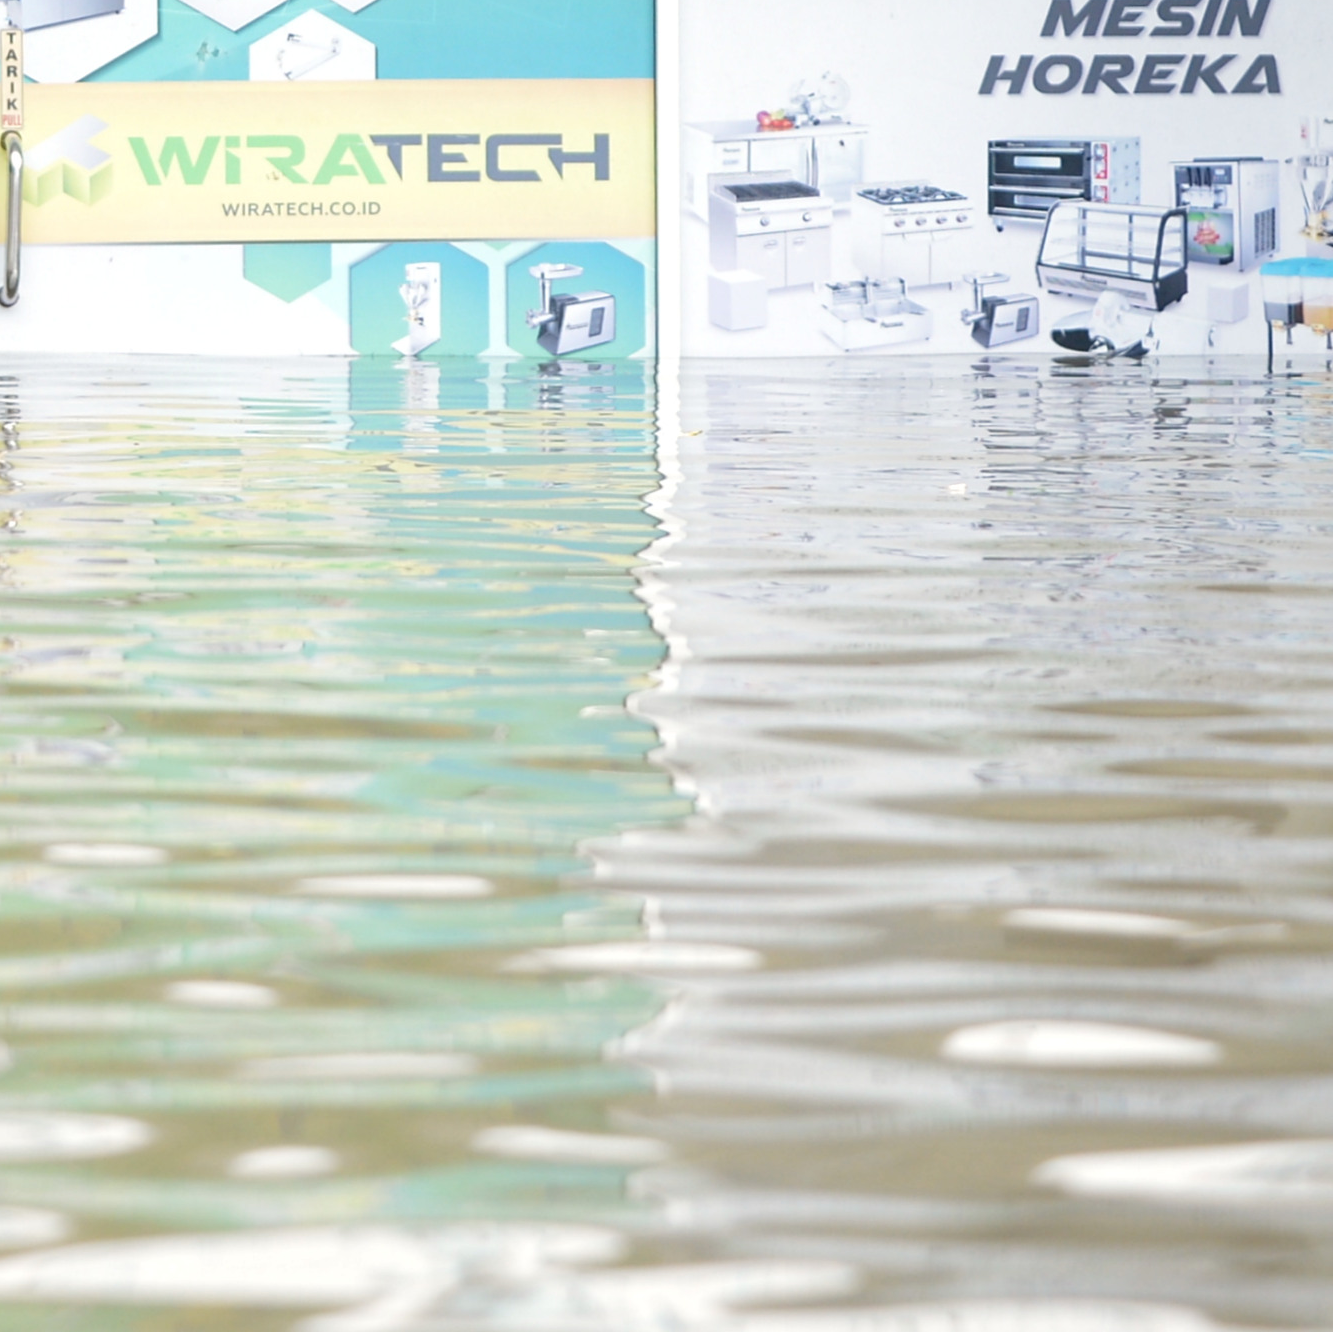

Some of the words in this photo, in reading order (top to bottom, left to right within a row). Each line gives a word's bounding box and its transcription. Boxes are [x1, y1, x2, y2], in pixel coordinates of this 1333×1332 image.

[6, 32, 18, 111] TARIK
[978, 54, 1281, 95] HOREKA
[2, 114, 22, 126] PULL
[222, 202, 381, 216] WIRATECH.CO.ID
